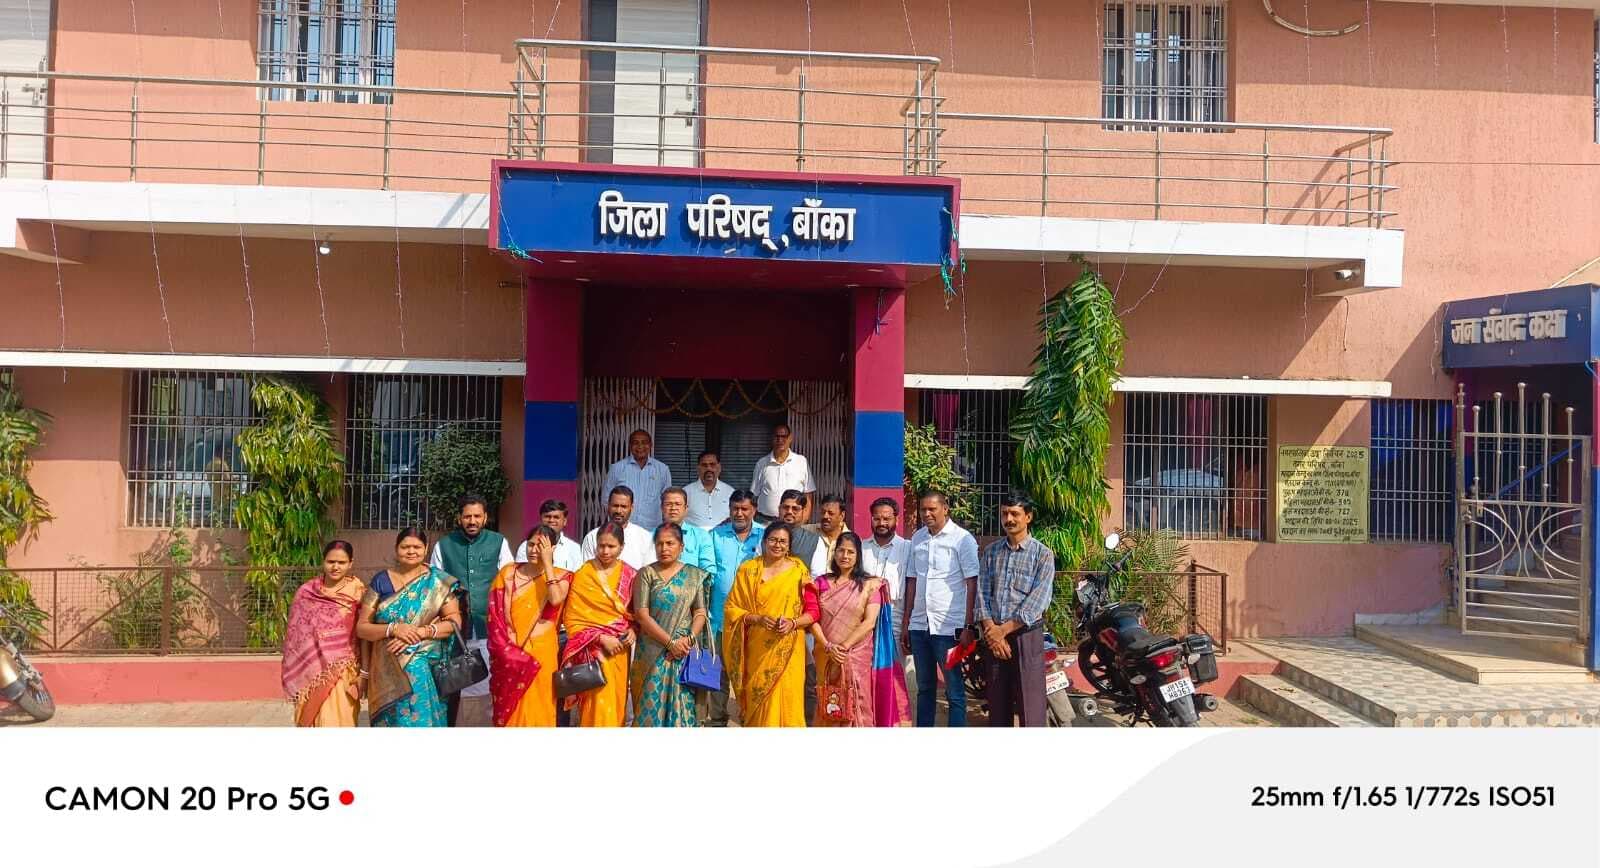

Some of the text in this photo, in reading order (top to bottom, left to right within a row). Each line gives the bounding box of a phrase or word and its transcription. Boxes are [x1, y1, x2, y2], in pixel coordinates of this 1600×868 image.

[598, 190, 669, 238] जिला
[1451, 318, 1482, 344] जन
[1528, 309, 1568, 339] कक्ष
